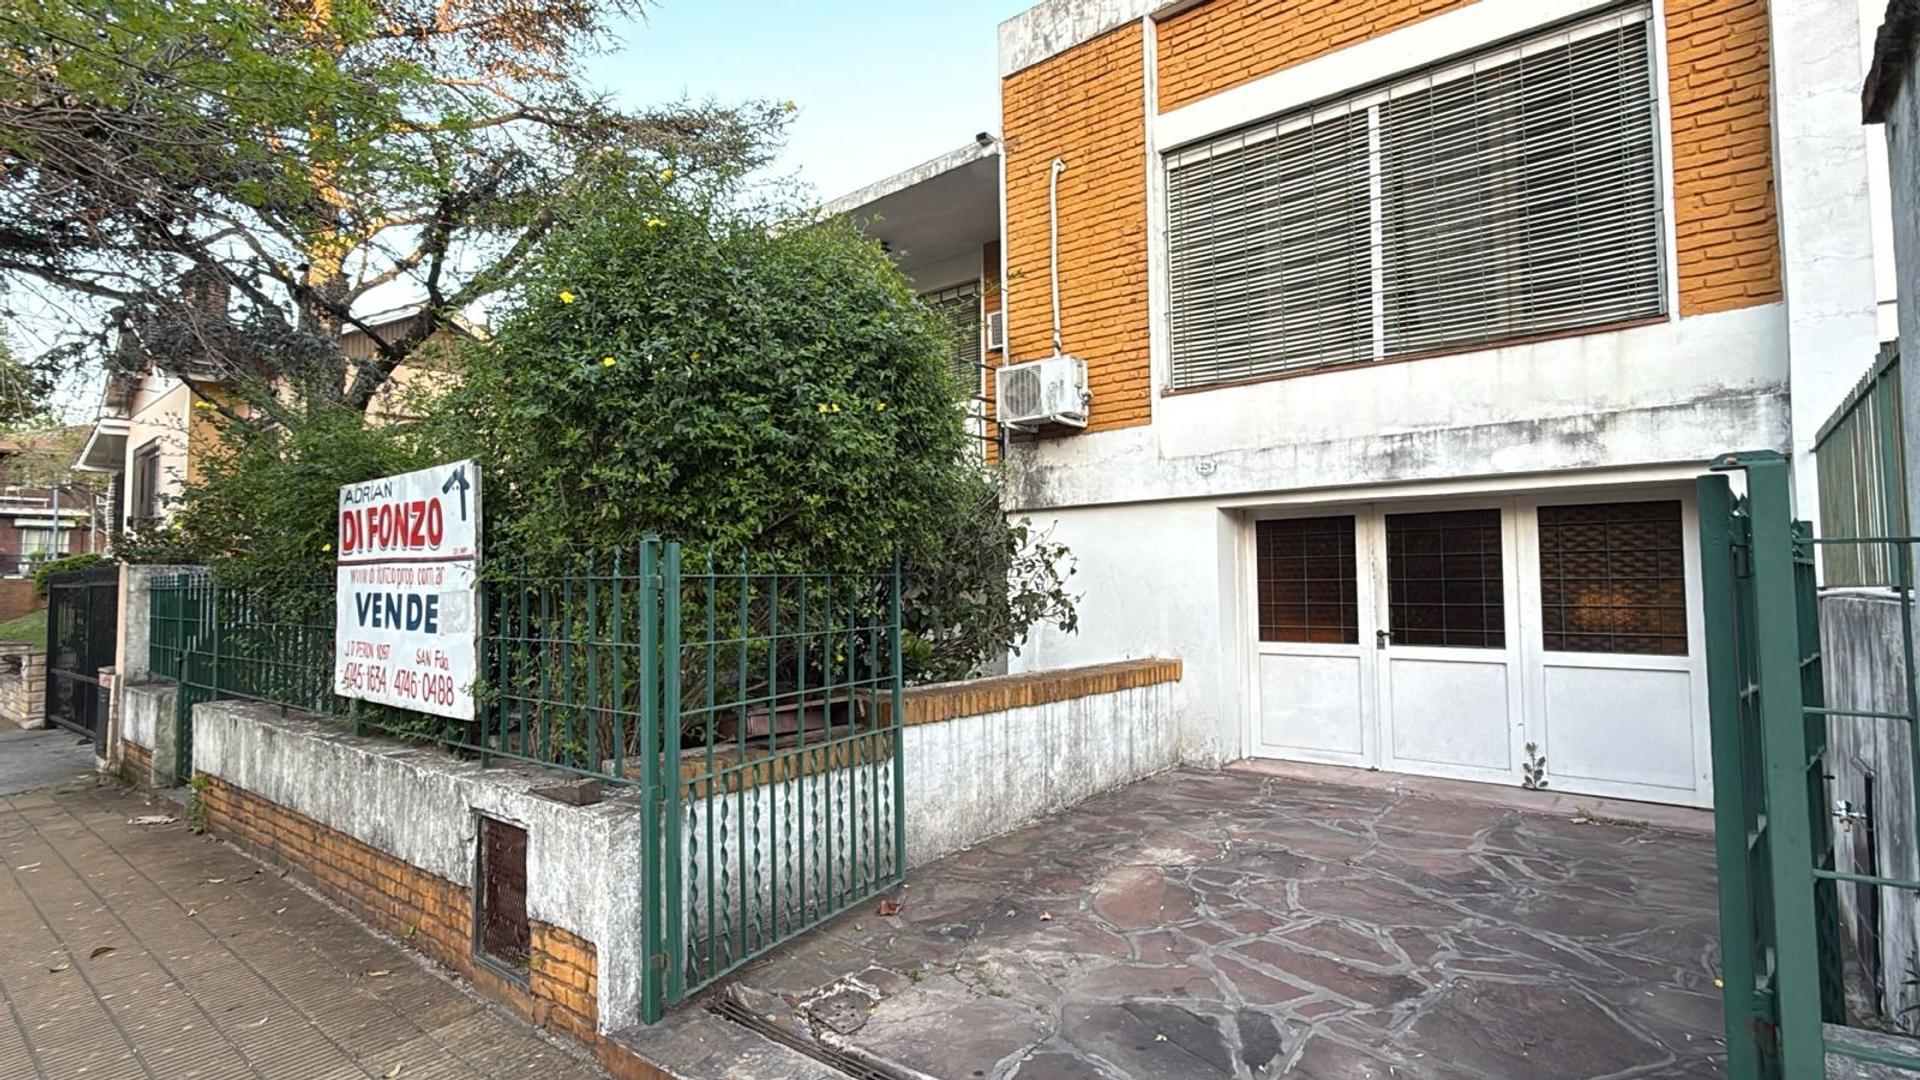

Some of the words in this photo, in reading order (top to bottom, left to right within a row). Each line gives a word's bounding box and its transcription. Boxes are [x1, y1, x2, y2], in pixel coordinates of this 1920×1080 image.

[344, 481, 393, 505] ADRIAN
[367, 497, 443, 552] FONZO
[355, 592, 438, 634] VENDE
[415, 647, 431, 667] SAN
